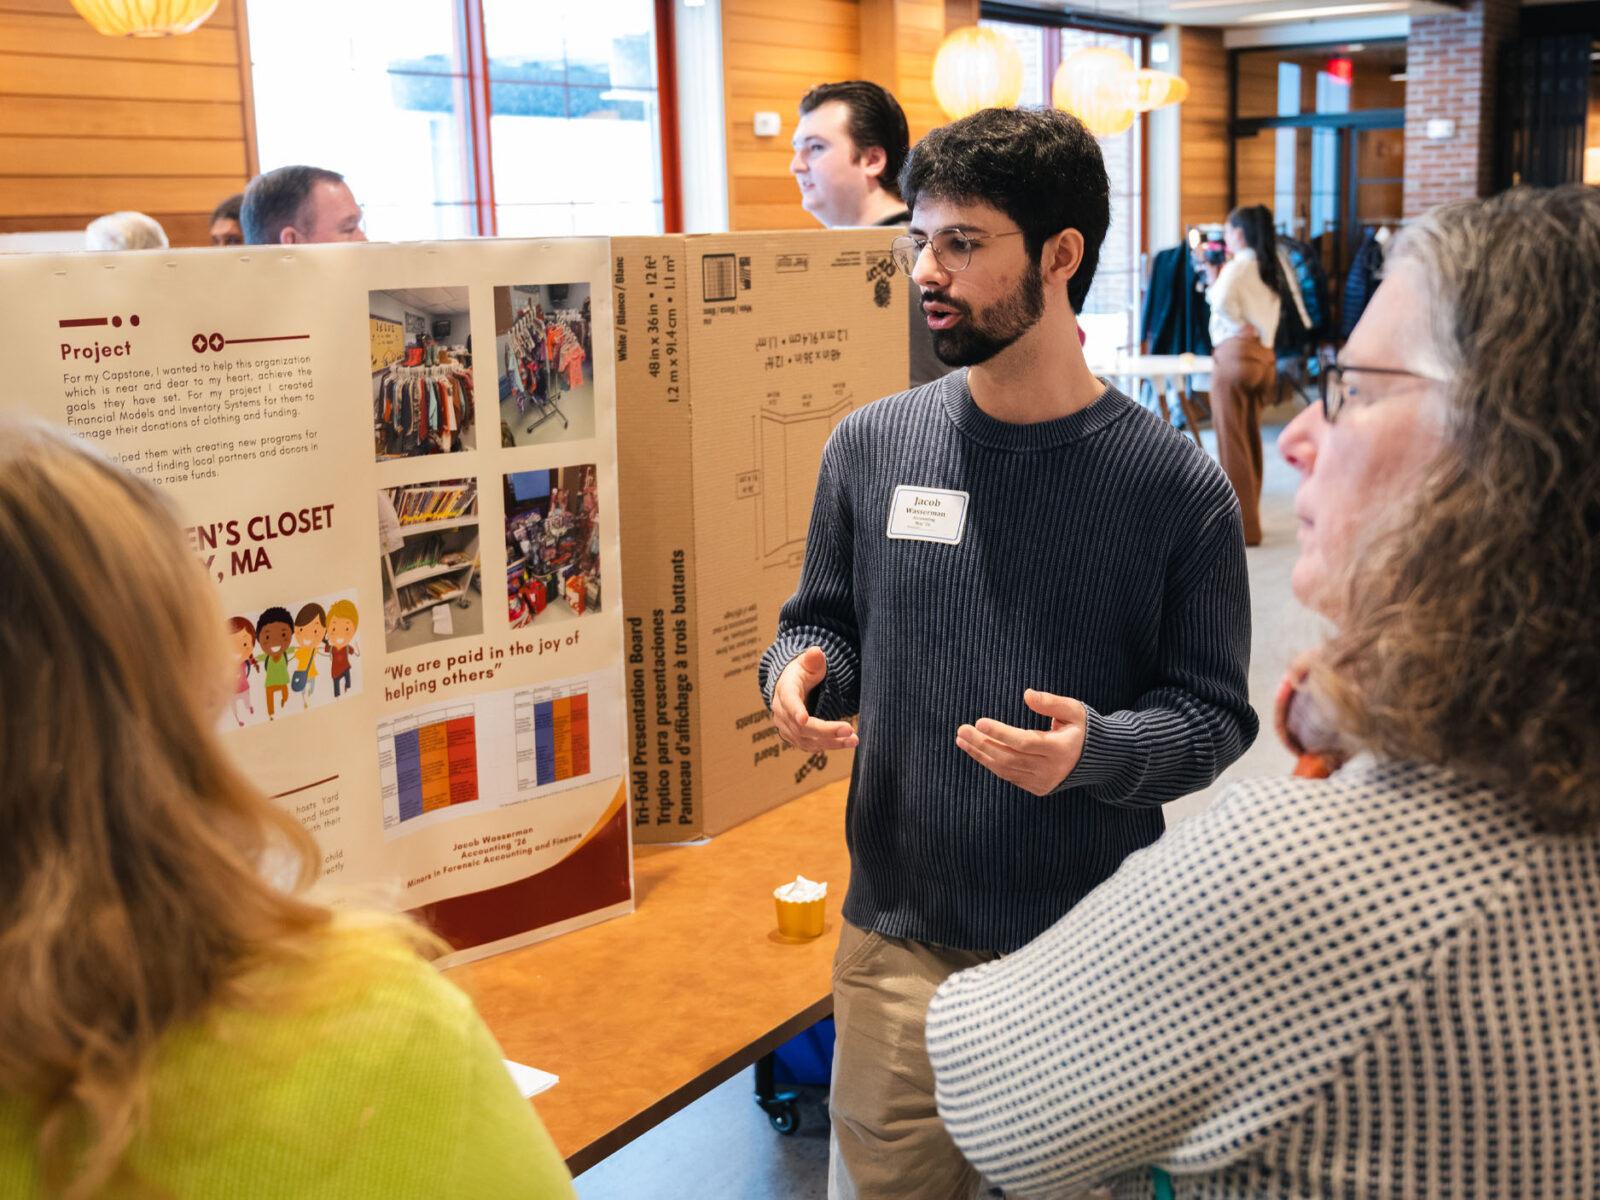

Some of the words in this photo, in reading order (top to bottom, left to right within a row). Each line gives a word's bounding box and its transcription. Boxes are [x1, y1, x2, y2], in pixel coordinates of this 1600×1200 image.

[615, 256, 625, 284] Blanc
[616, 292, 626, 325] Blanco
[60, 340, 131, 363] Project
[617, 334, 628, 362] White
[63, 373, 81, 384] For
[85, 374, 99, 384] my
[102, 369, 154, 382] Capstone,
[162, 362, 198, 375] wanted
[201, 363, 210, 372] to
[213, 360, 233, 372] help
[236, 358, 252, 369] this
[255, 355, 311, 369] organization
[65, 385, 96, 398] which
[102, 386, 110, 395] is
[116, 384, 138, 393] near
[144, 379, 162, 391] and
[167, 378, 189, 389] dear
[194, 378, 204, 386] to
[209, 377, 221, 387] my
[258, 370, 293, 380] achieve
[298, 367, 312, 376] the
[66, 400, 96, 415] goals
[104, 398, 126, 409] they
[133, 395, 156, 406] have
[163, 394, 181, 403] set.
[188, 390, 203, 400] For
[210, 390, 222, 400] my
[229, 385, 262, 397] project
[279, 379, 313, 391] created
[67, 411, 116, 426] Financial
[119, 407, 155, 421] Models
[158, 405, 176, 417] and
[180, 403, 221, 414] Inventory
[224, 398, 261, 412] Systems
[264, 395, 277, 405] for
[280, 394, 303, 403] them
[305, 393, 315, 401] to
[668, 386, 680, 403] 1.2
[116, 425, 138, 435] their
[141, 419, 188, 432] donations
[191, 416, 200, 426] of
[203, 413, 241, 425] clothing
[243, 409, 261, 421] and
[135, 464, 154, 474] and
[157, 459, 190, 470] finding
[192, 454, 215, 466] local
[218, 451, 257, 466] partners
[259, 447, 277, 458] and
[279, 444, 309, 456] donors
[311, 443, 319, 451] in
[144, 448, 168, 459] them
[172, 444, 192, 456] with
[195, 440, 235, 453] creating
[238, 438, 257, 447] new
[260, 432, 303, 447] programs
[305, 429, 318, 439] for
[152, 477, 163, 485] to
[165, 474, 188, 484] raise
[906, 507, 946, 517] Wasserman
[914, 496, 941, 507] Jacob
[247, 503, 335, 542] CLOSET
[231, 546, 272, 576] MA
[670, 549, 686, 614] battants
[416, 659, 441, 673] are
[447, 646, 483, 671] paid
[490, 646, 504, 659] in
[509, 641, 534, 656] the
[538, 638, 561, 656] joy
[566, 629, 580, 646] of
[626, 617, 644, 664] Board
[672, 619, 688, 655] trois
[651, 608, 672, 726] presentaciones
[385, 679, 437, 702] helping
[630, 668, 647, 766] Presentation
[674, 673, 693, 756] d'affichage
[657, 730, 673, 765] para
[296, 802, 317, 814] hosts
[321, 793, 340, 805] Yard
[632, 770, 650, 827] Tri-Fold
[678, 760, 693, 825] Panneau
[301, 813, 317, 824] and
[324, 816, 342, 828] their
[453, 838, 480, 851] Jacob
[482, 827, 533, 844] Wasserman
[461, 842, 512, 859] Accounting
[324, 849, 344, 863] child
[407, 873, 432, 888] Minors
[433, 869, 441, 877] in
[443, 859, 480, 874] Forensic
[483, 847, 533, 864] Accounting
[535, 840, 551, 851] and
[552, 833, 583, 846] Finance
